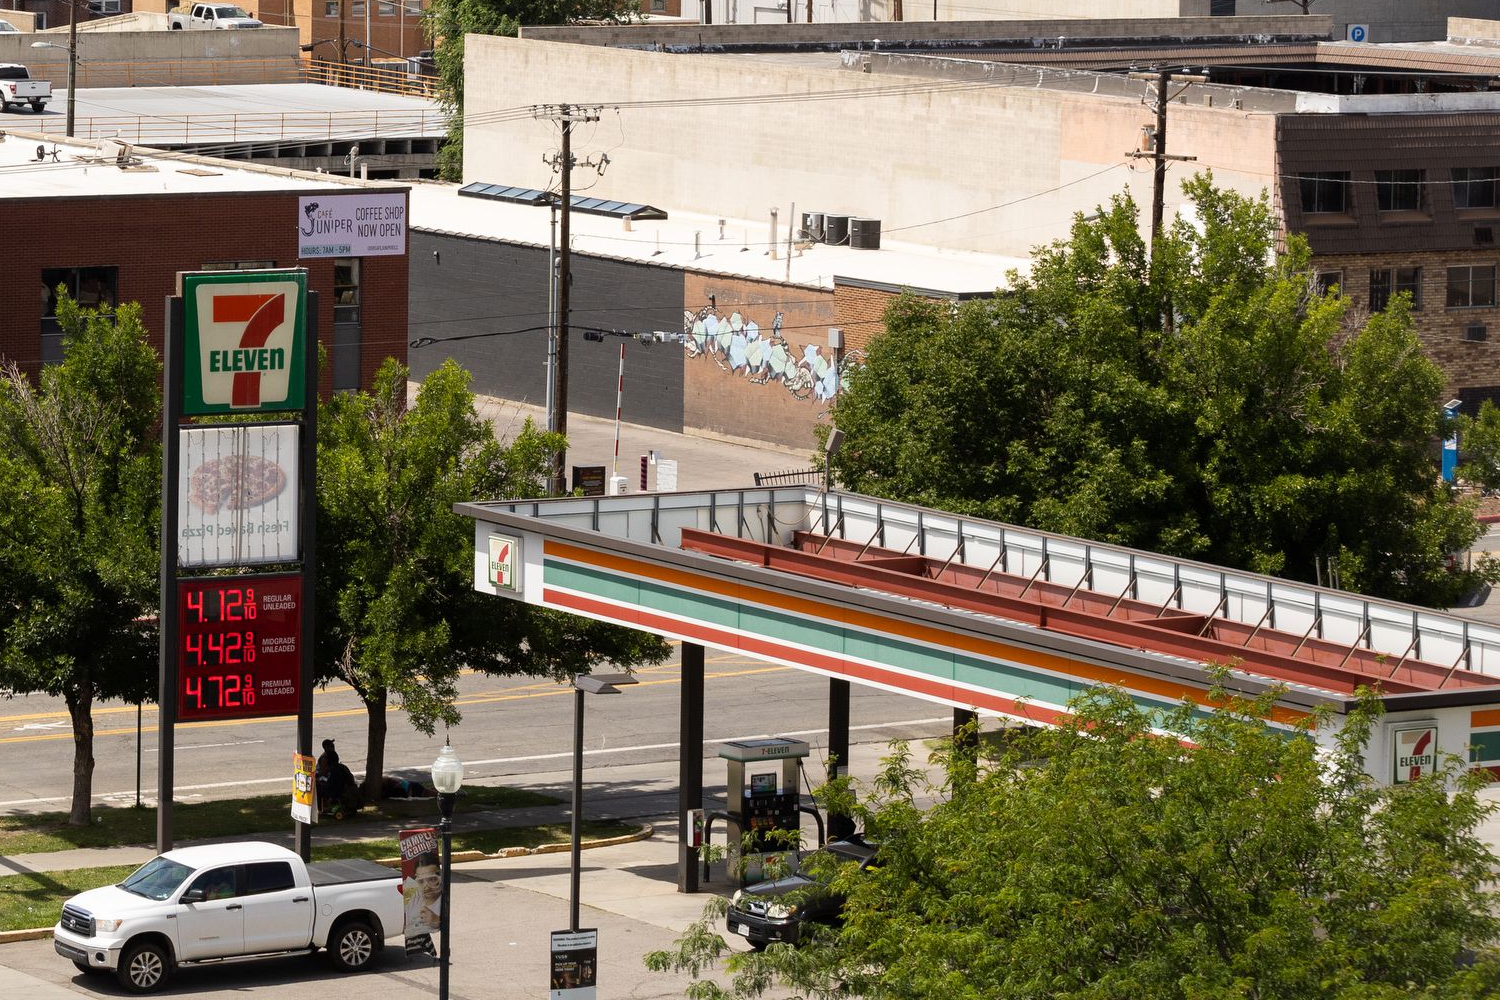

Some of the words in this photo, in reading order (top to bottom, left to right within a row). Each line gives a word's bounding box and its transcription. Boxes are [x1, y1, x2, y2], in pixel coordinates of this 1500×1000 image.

[355, 207, 382, 221] COFFEE
[384, 206, 404, 220] SHOP
[358, 224, 378, 237] NOW
[380, 223, 401, 237] OPEN
[339, 245, 351, 254] 5PM
[212, 293, 285, 406] 7
[263, 594, 292, 602] REGULAR
[263, 602, 296, 611] UNLEADED
[262, 637, 296, 645] MIDGRADE
[262, 645, 296, 653] UNLEADED
[261, 679, 292, 687] PREMIUM
[261, 687, 295, 696] UNLEADED
